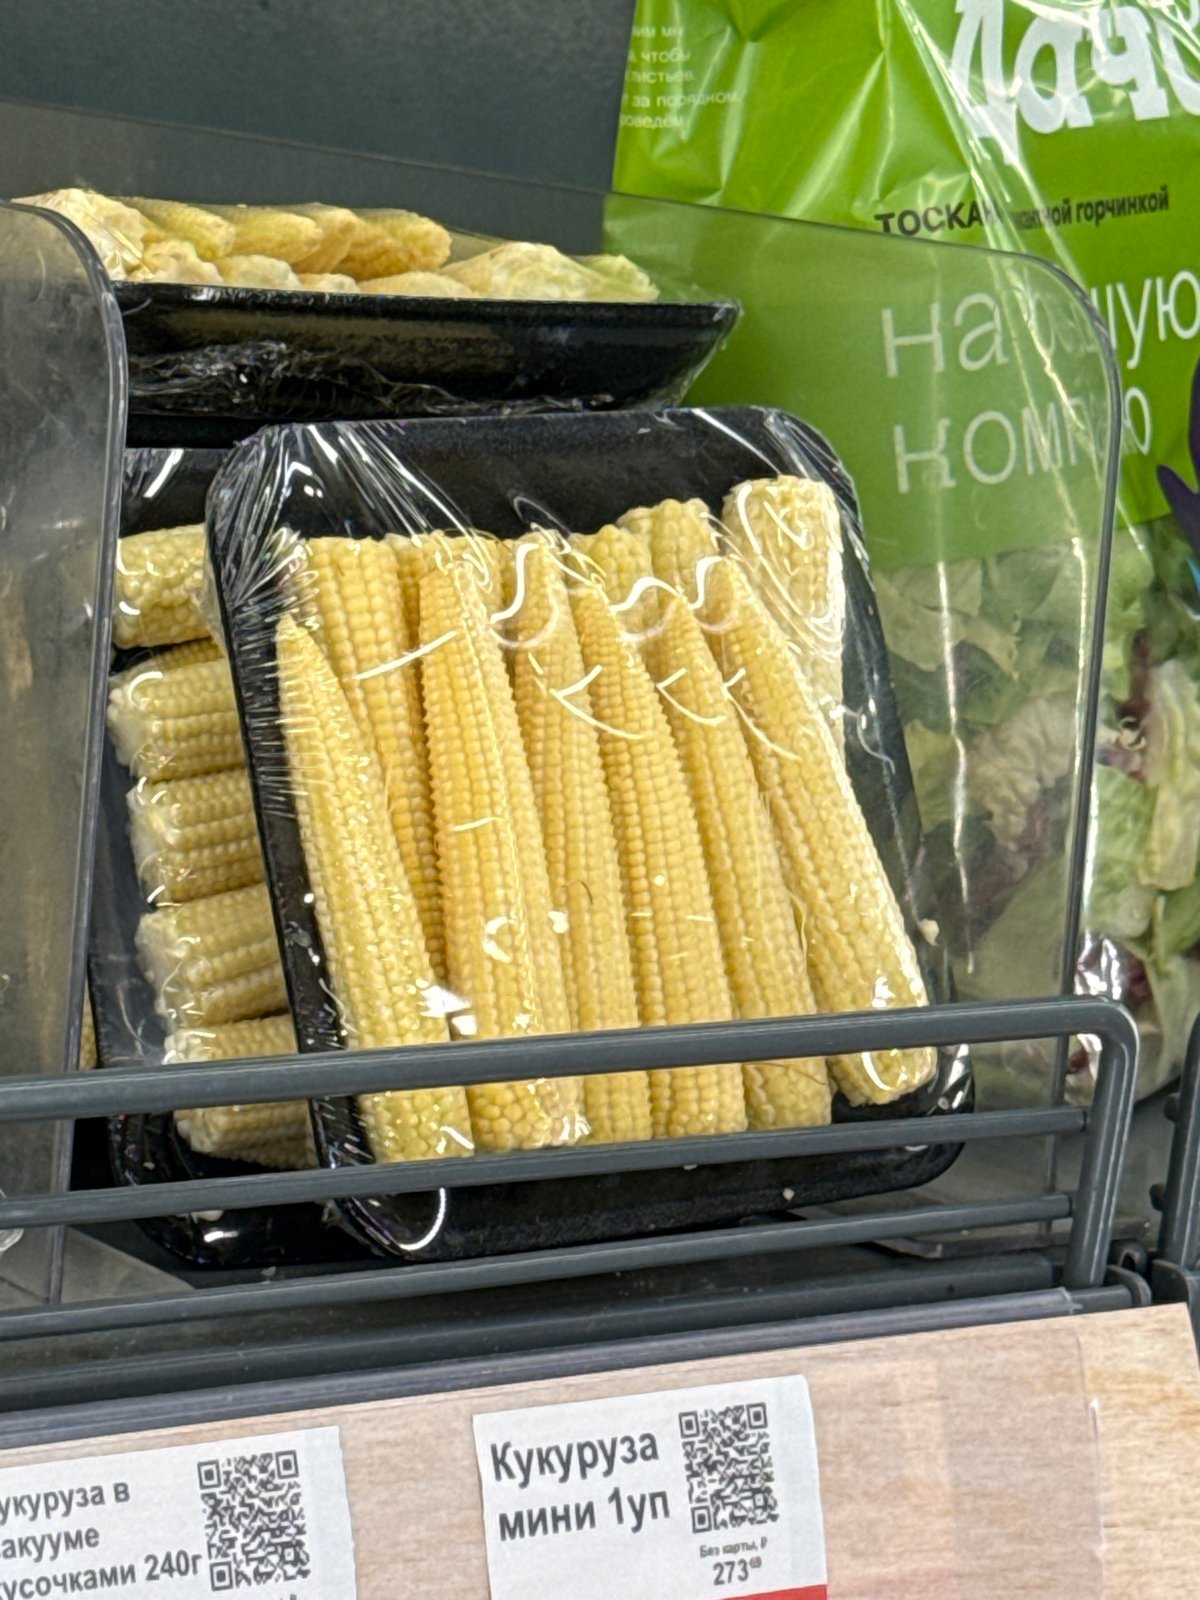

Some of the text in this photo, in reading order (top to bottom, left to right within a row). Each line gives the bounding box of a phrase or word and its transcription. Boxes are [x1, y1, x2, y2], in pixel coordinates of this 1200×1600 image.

[1076, 184, 1170, 227] горчинкой
[490, 1432, 660, 1489] Кукуруза
[0, 1482, 131, 1527] укуруза в
[499, 1486, 671, 1542] мини 1уп
[0, 1526, 101, 1564] акууме
[0, 1550, 203, 1600] усочками 240г
[712, 1558, 750, 1587] 273
